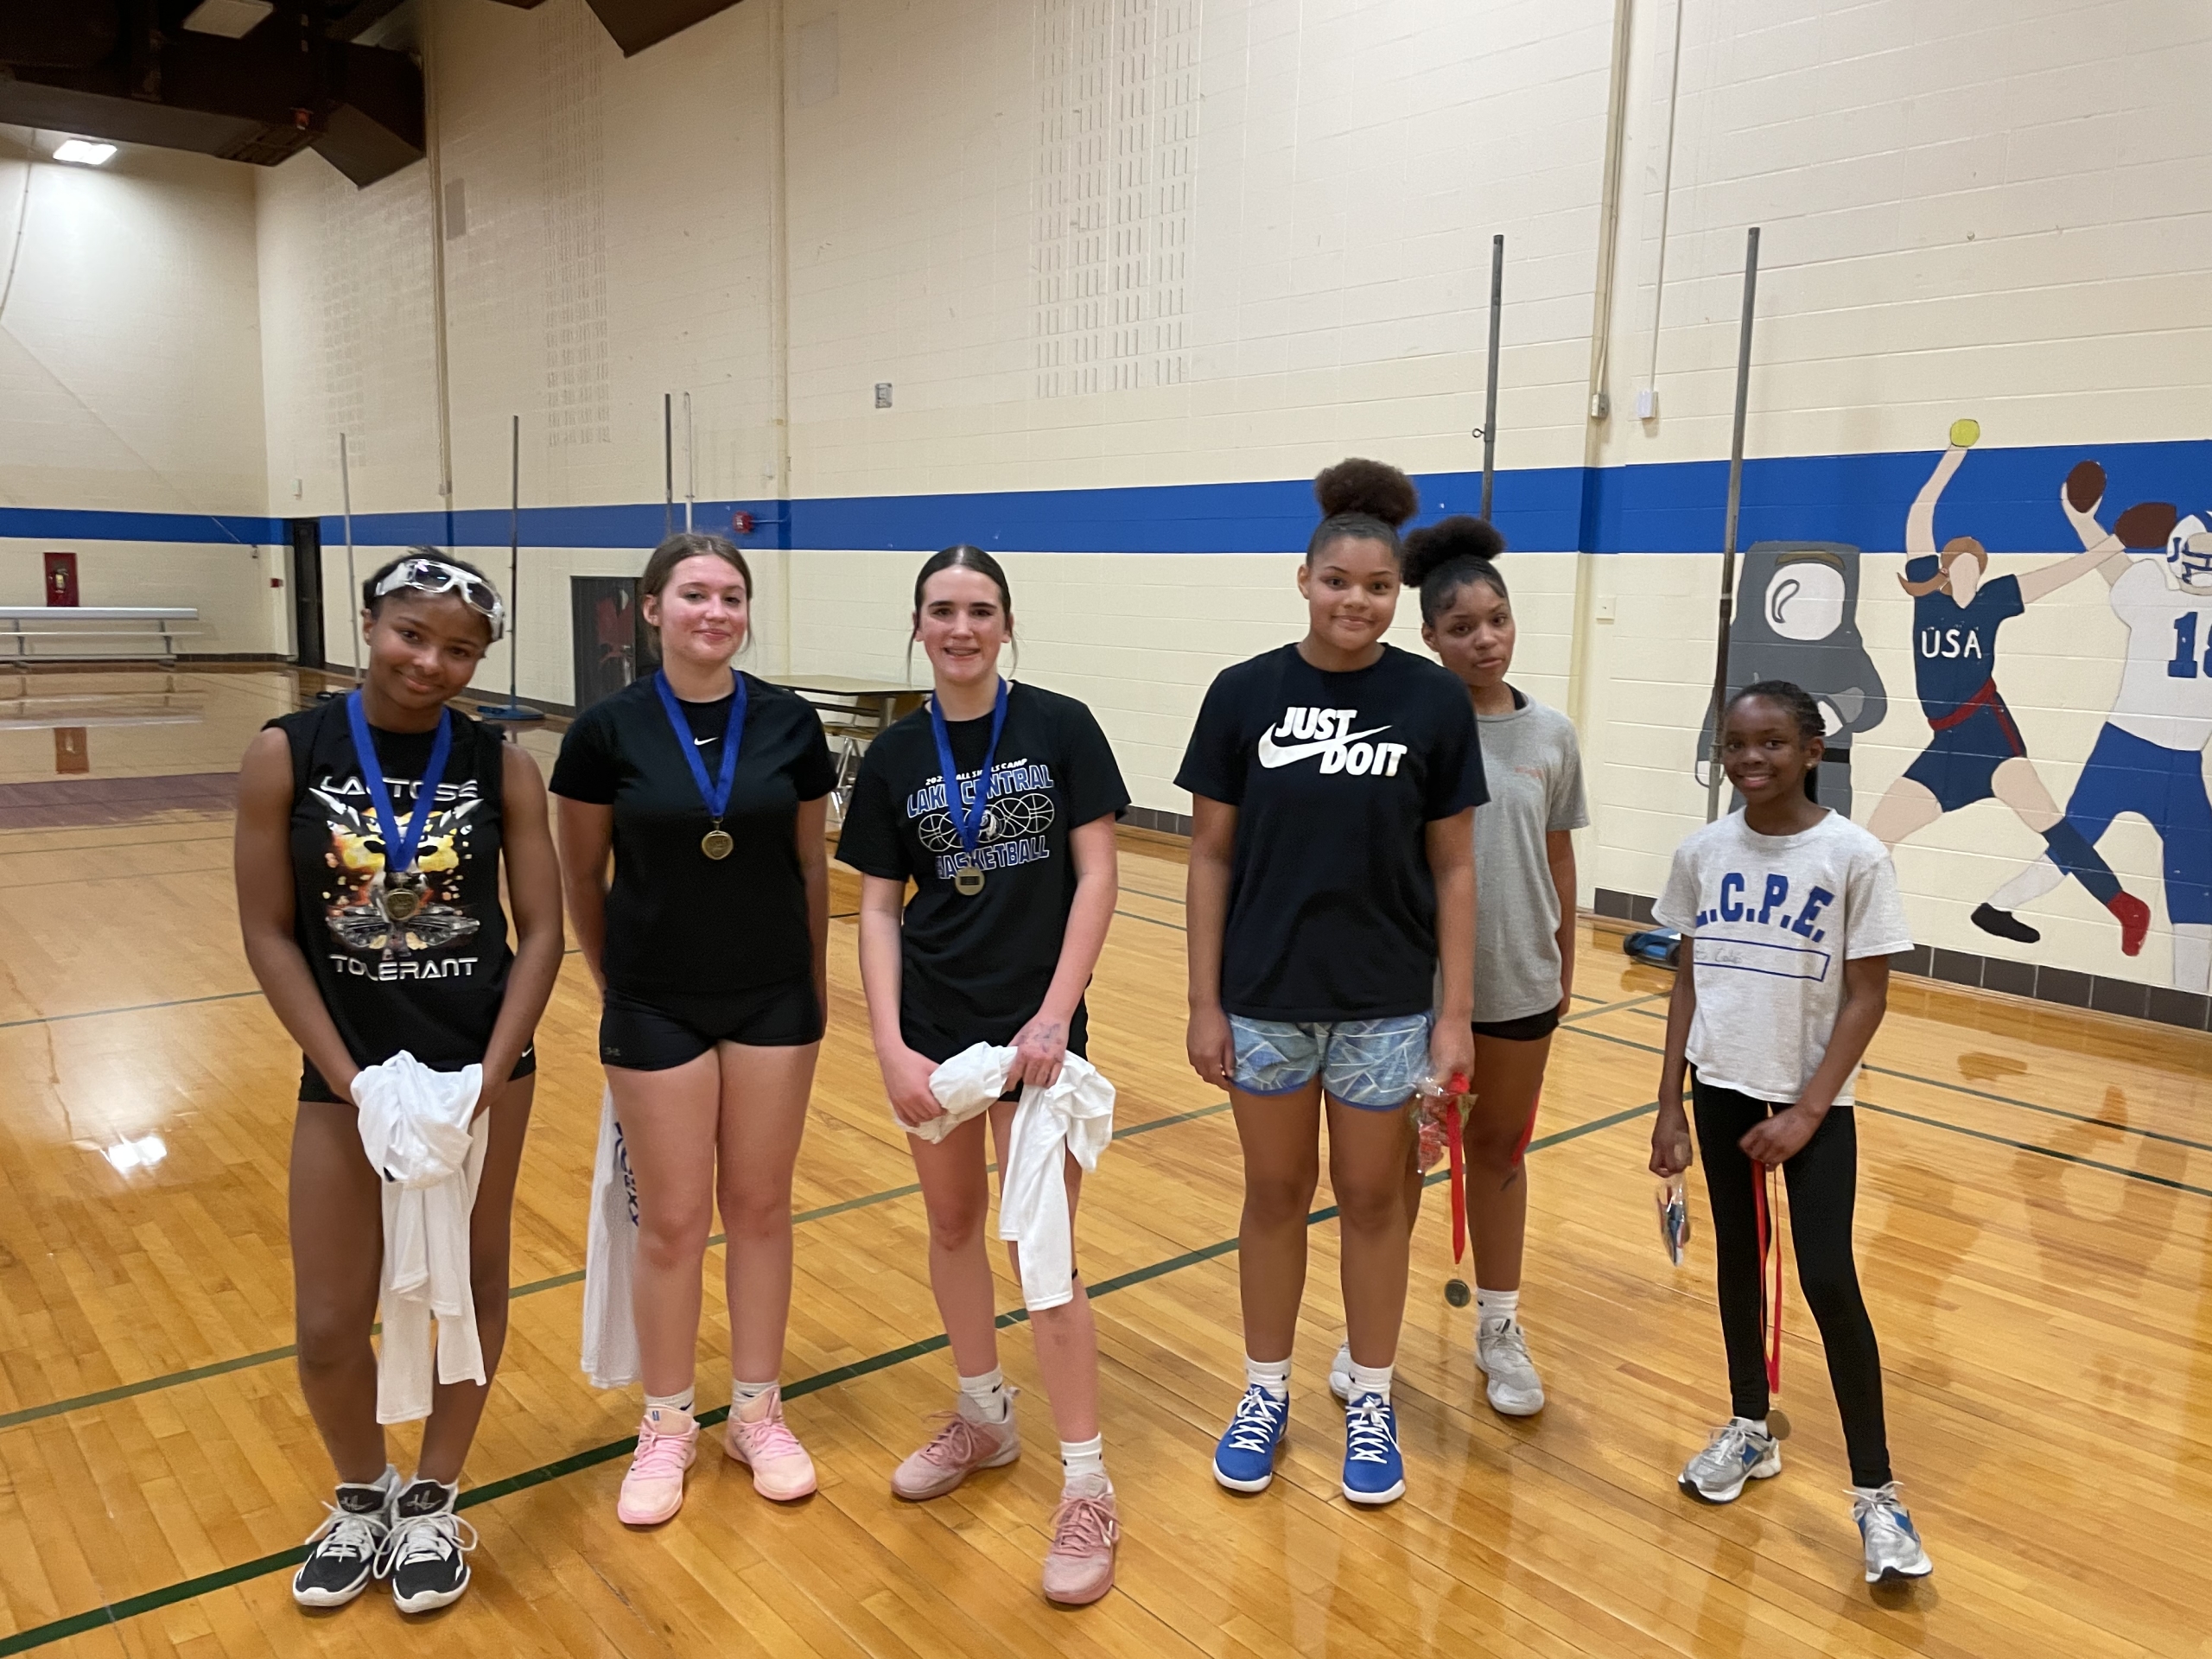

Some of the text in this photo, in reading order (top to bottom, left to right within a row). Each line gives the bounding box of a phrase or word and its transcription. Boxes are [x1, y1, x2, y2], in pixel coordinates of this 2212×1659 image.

[1921, 628, 1983, 659] USA
[2167, 611, 2212, 679] 1
[1274, 706, 1358, 741] JUST
[925, 758, 1028, 786] 202 ALL SKLS CAMP
[320, 775, 479, 802] LATOSE
[1695, 872, 1835, 943] .C.P.E.
[328, 953, 479, 981] TOLERANT
